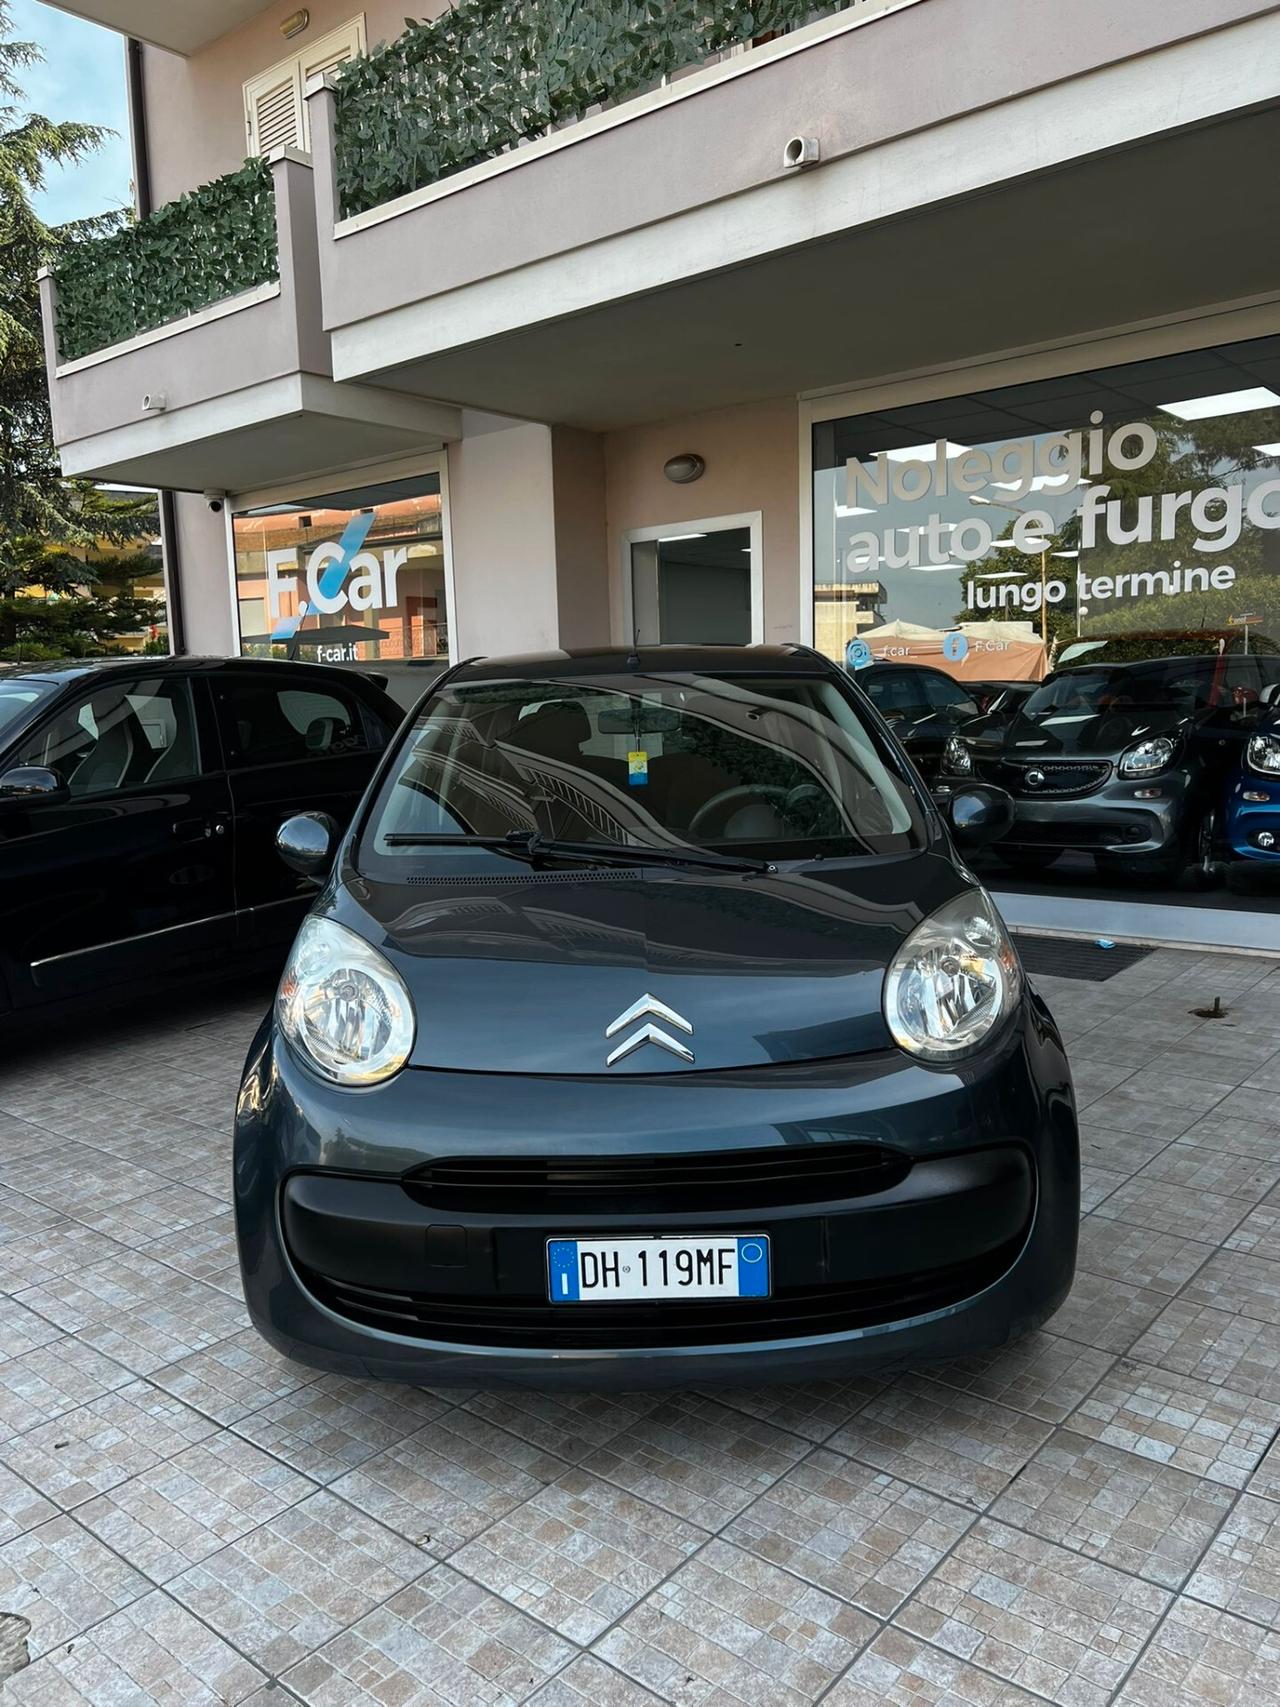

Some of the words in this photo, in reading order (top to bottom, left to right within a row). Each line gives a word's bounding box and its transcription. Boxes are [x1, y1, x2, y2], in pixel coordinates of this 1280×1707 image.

[845, 410, 1157, 508] Noleggio
[847, 513, 993, 573] auto
[1012, 509, 1056, 555] e
[1077, 479, 1280, 552] furgo
[967, 580, 1066, 612] lungo
[1078, 561, 1236, 600] termine
[317, 643, 359, 663] f-car.it
